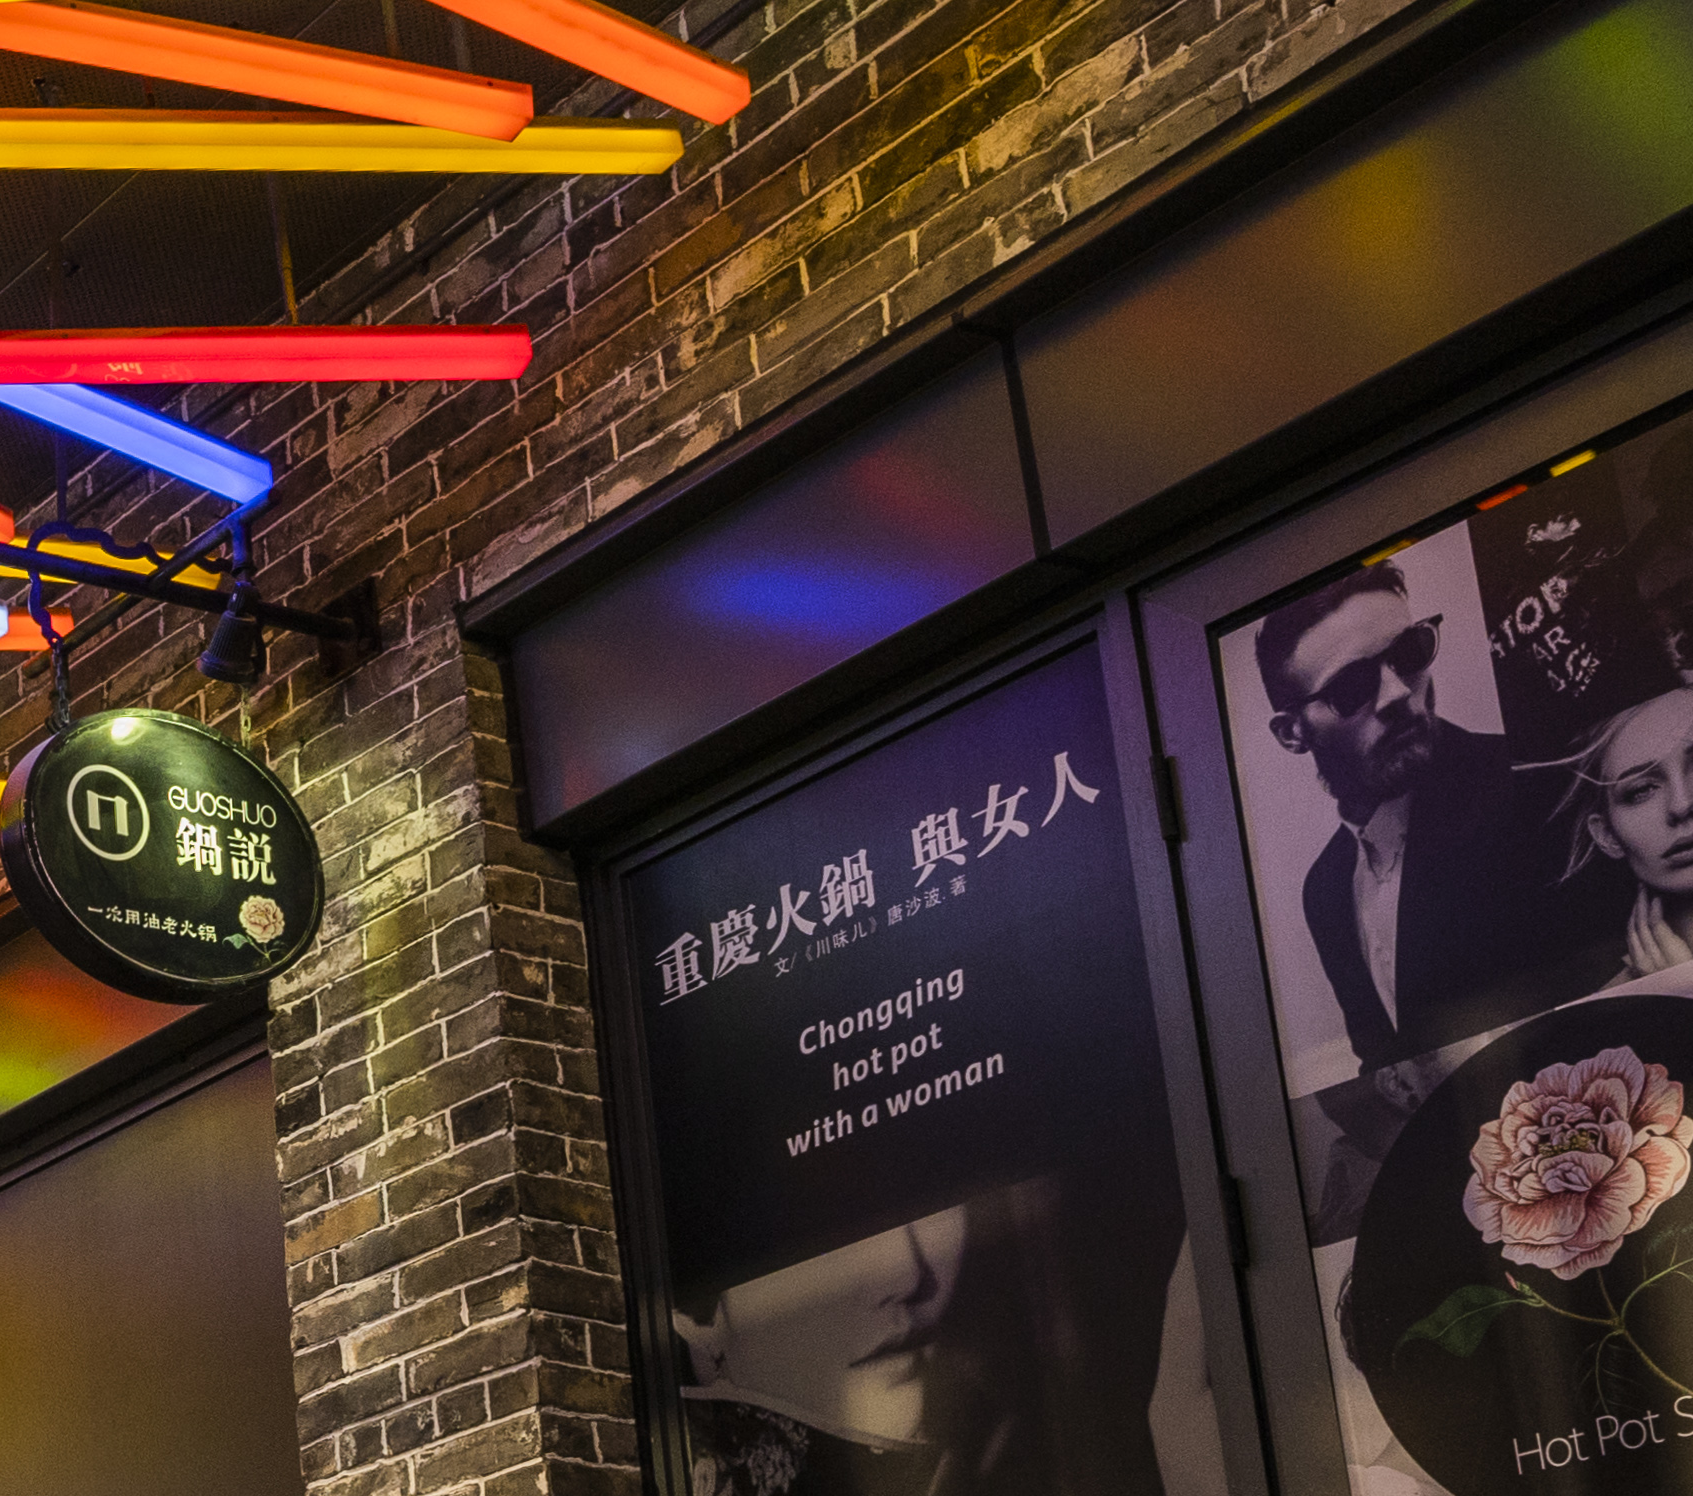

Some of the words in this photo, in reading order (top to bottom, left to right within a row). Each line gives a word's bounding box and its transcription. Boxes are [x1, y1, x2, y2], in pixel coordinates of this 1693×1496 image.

[167, 785, 277, 828] GUOSHUO
[88, 905, 217, 943] 一次用油老火锅
[654, 848, 876, 1006] 重慶火鍋
[798, 967, 965, 1055] Chongqing
[832, 1048, 884, 1091] hot
[890, 1022, 943, 1076] pot
[786, 1108, 854, 1157] with
[861, 1102, 879, 1129] a
[885, 1051, 1006, 1118] woman
[1513, 1426, 1590, 1475] Hot
[1596, 1410, 1666, 1456] Pot
